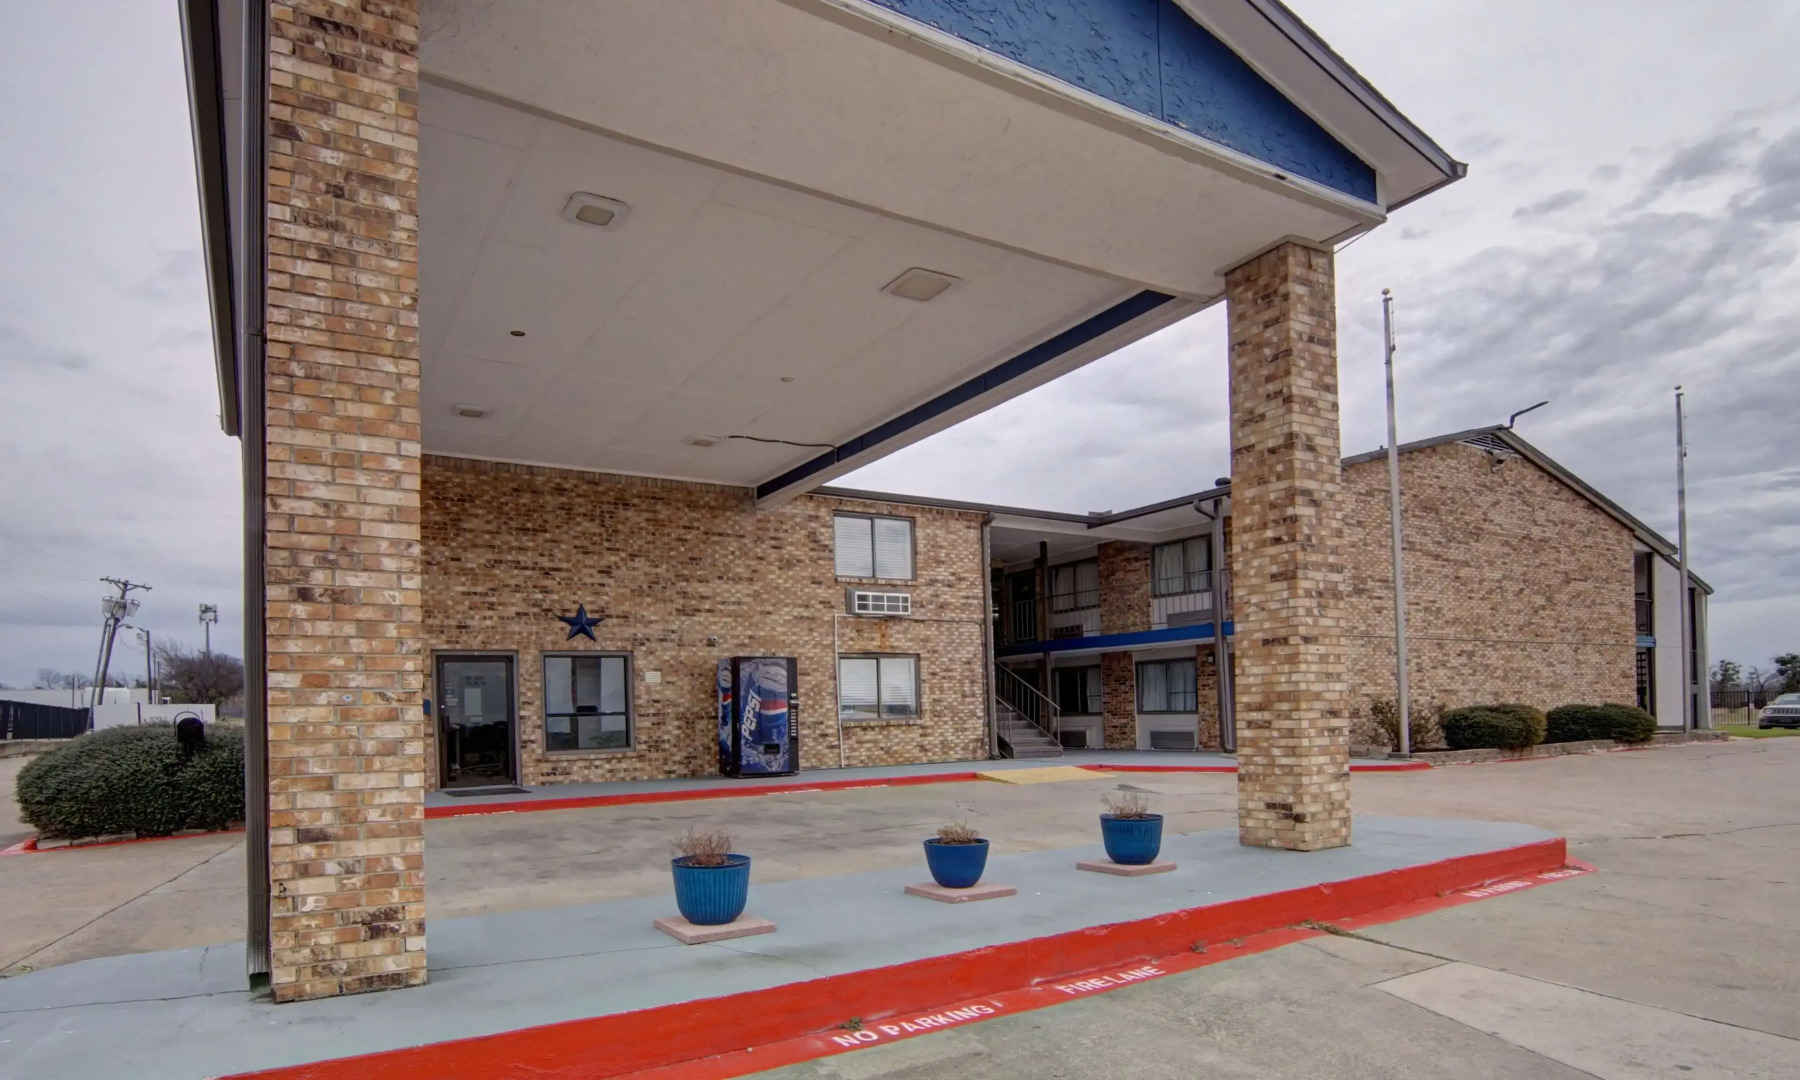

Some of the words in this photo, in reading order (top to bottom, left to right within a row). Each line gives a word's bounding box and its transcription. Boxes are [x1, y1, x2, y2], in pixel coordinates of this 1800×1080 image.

[741, 688, 762, 741] PEPSI
[1054, 978, 1115, 995] FIRE
[1103, 966, 1166, 984] LANE
[832, 1031, 878, 1047] NO
[879, 1005, 995, 1036] PARKING
